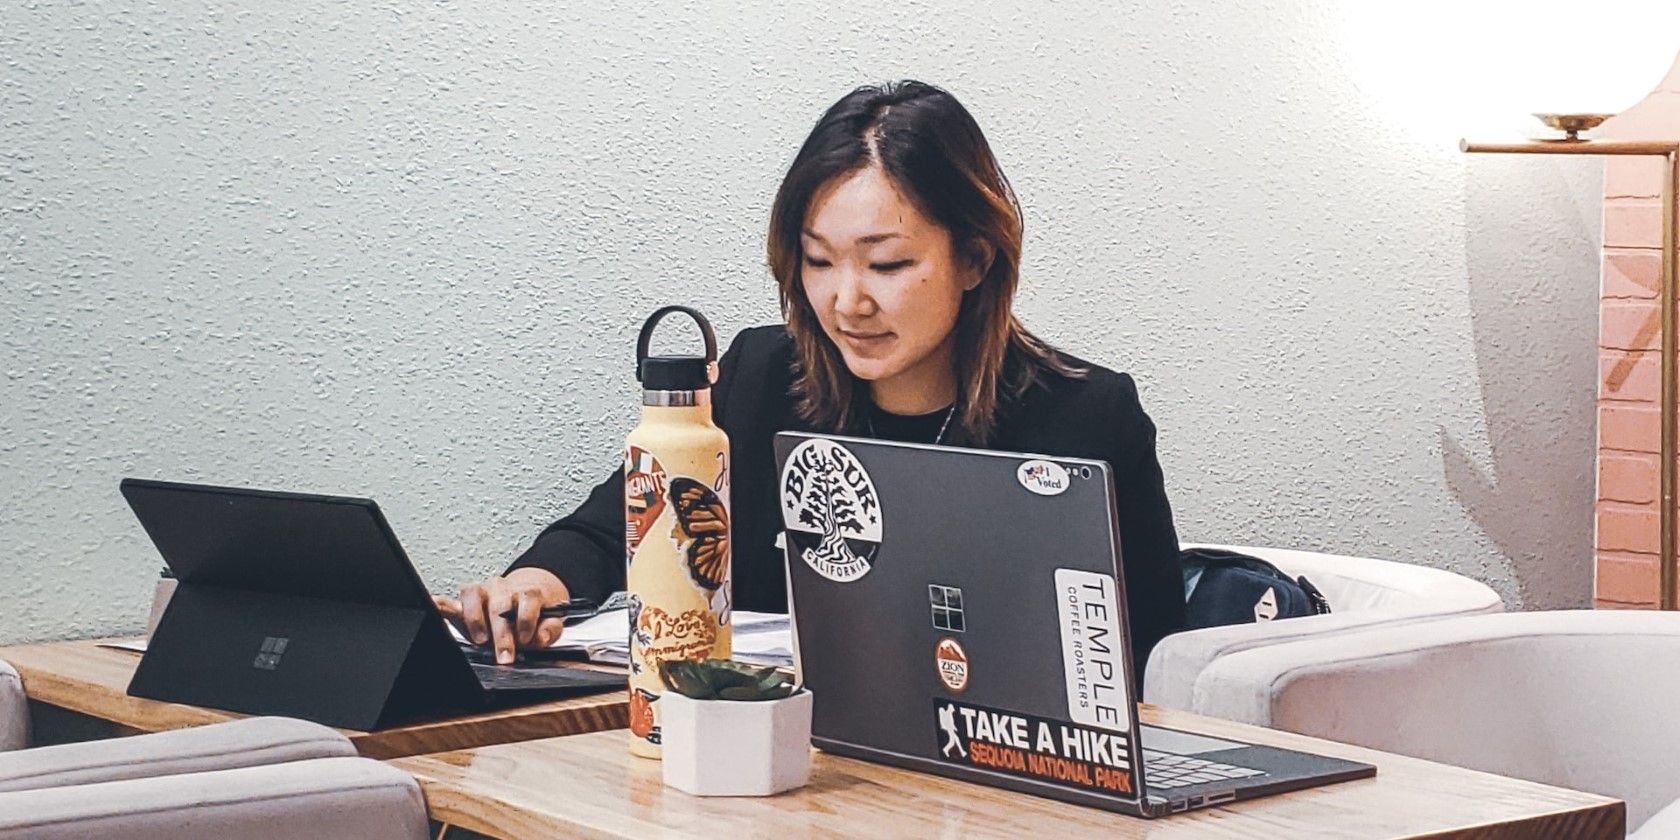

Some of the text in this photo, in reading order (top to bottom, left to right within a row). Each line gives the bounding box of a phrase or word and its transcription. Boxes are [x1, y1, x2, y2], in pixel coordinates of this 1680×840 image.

[786, 444, 817, 503] BIG
[831, 447, 876, 515] SUR
[1036, 476, 1062, 489] Voted
[1045, 467, 1050, 477] I
[807, 550, 867, 578] CALIFORNIA
[941, 661, 965, 673] ZION
[1067, 586, 1089, 709] COFFEE ROASTERS
[1082, 578, 1118, 725] TEMPLE
[959, 706, 1130, 770] TAKE A HIKE
[969, 741, 1132, 793] SEQUOIA NATIONAL PARK
